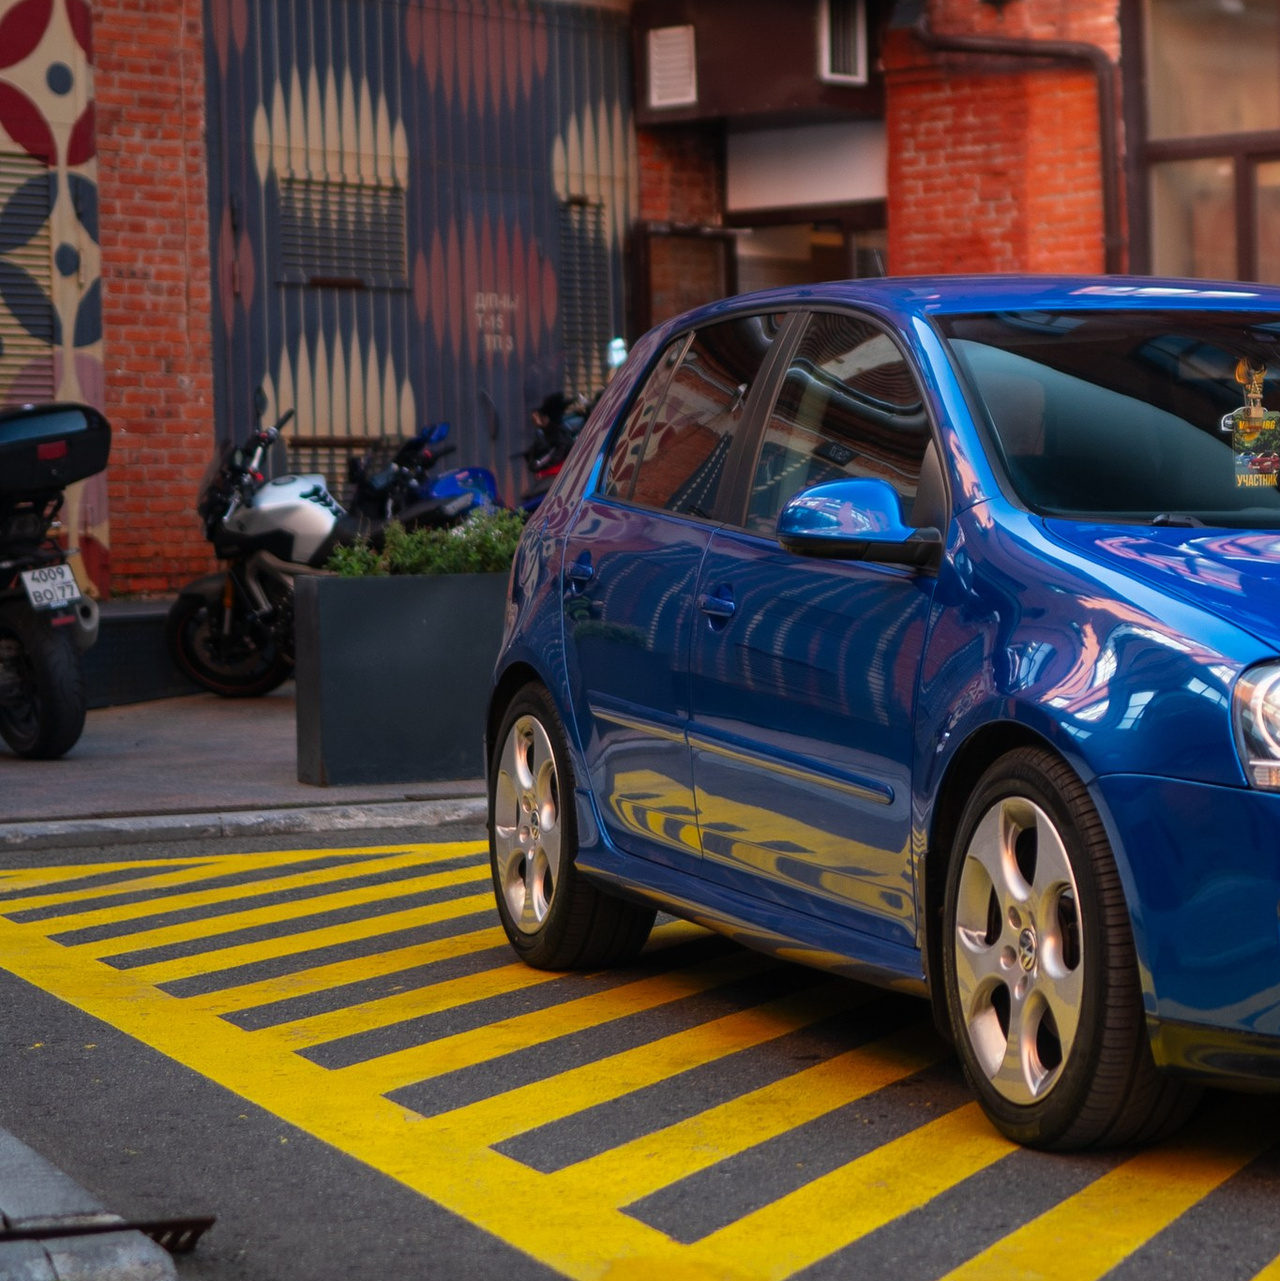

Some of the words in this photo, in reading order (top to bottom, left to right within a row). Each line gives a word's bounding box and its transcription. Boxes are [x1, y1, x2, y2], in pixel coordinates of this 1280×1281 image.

[1239, 420, 1276, 430] VARG
[1237, 474, 1277, 487] УЧАСТНИК
[32, 567, 65, 582] 4009
[32, 588, 55, 603] ВО
[57, 584, 75, 598] 77
